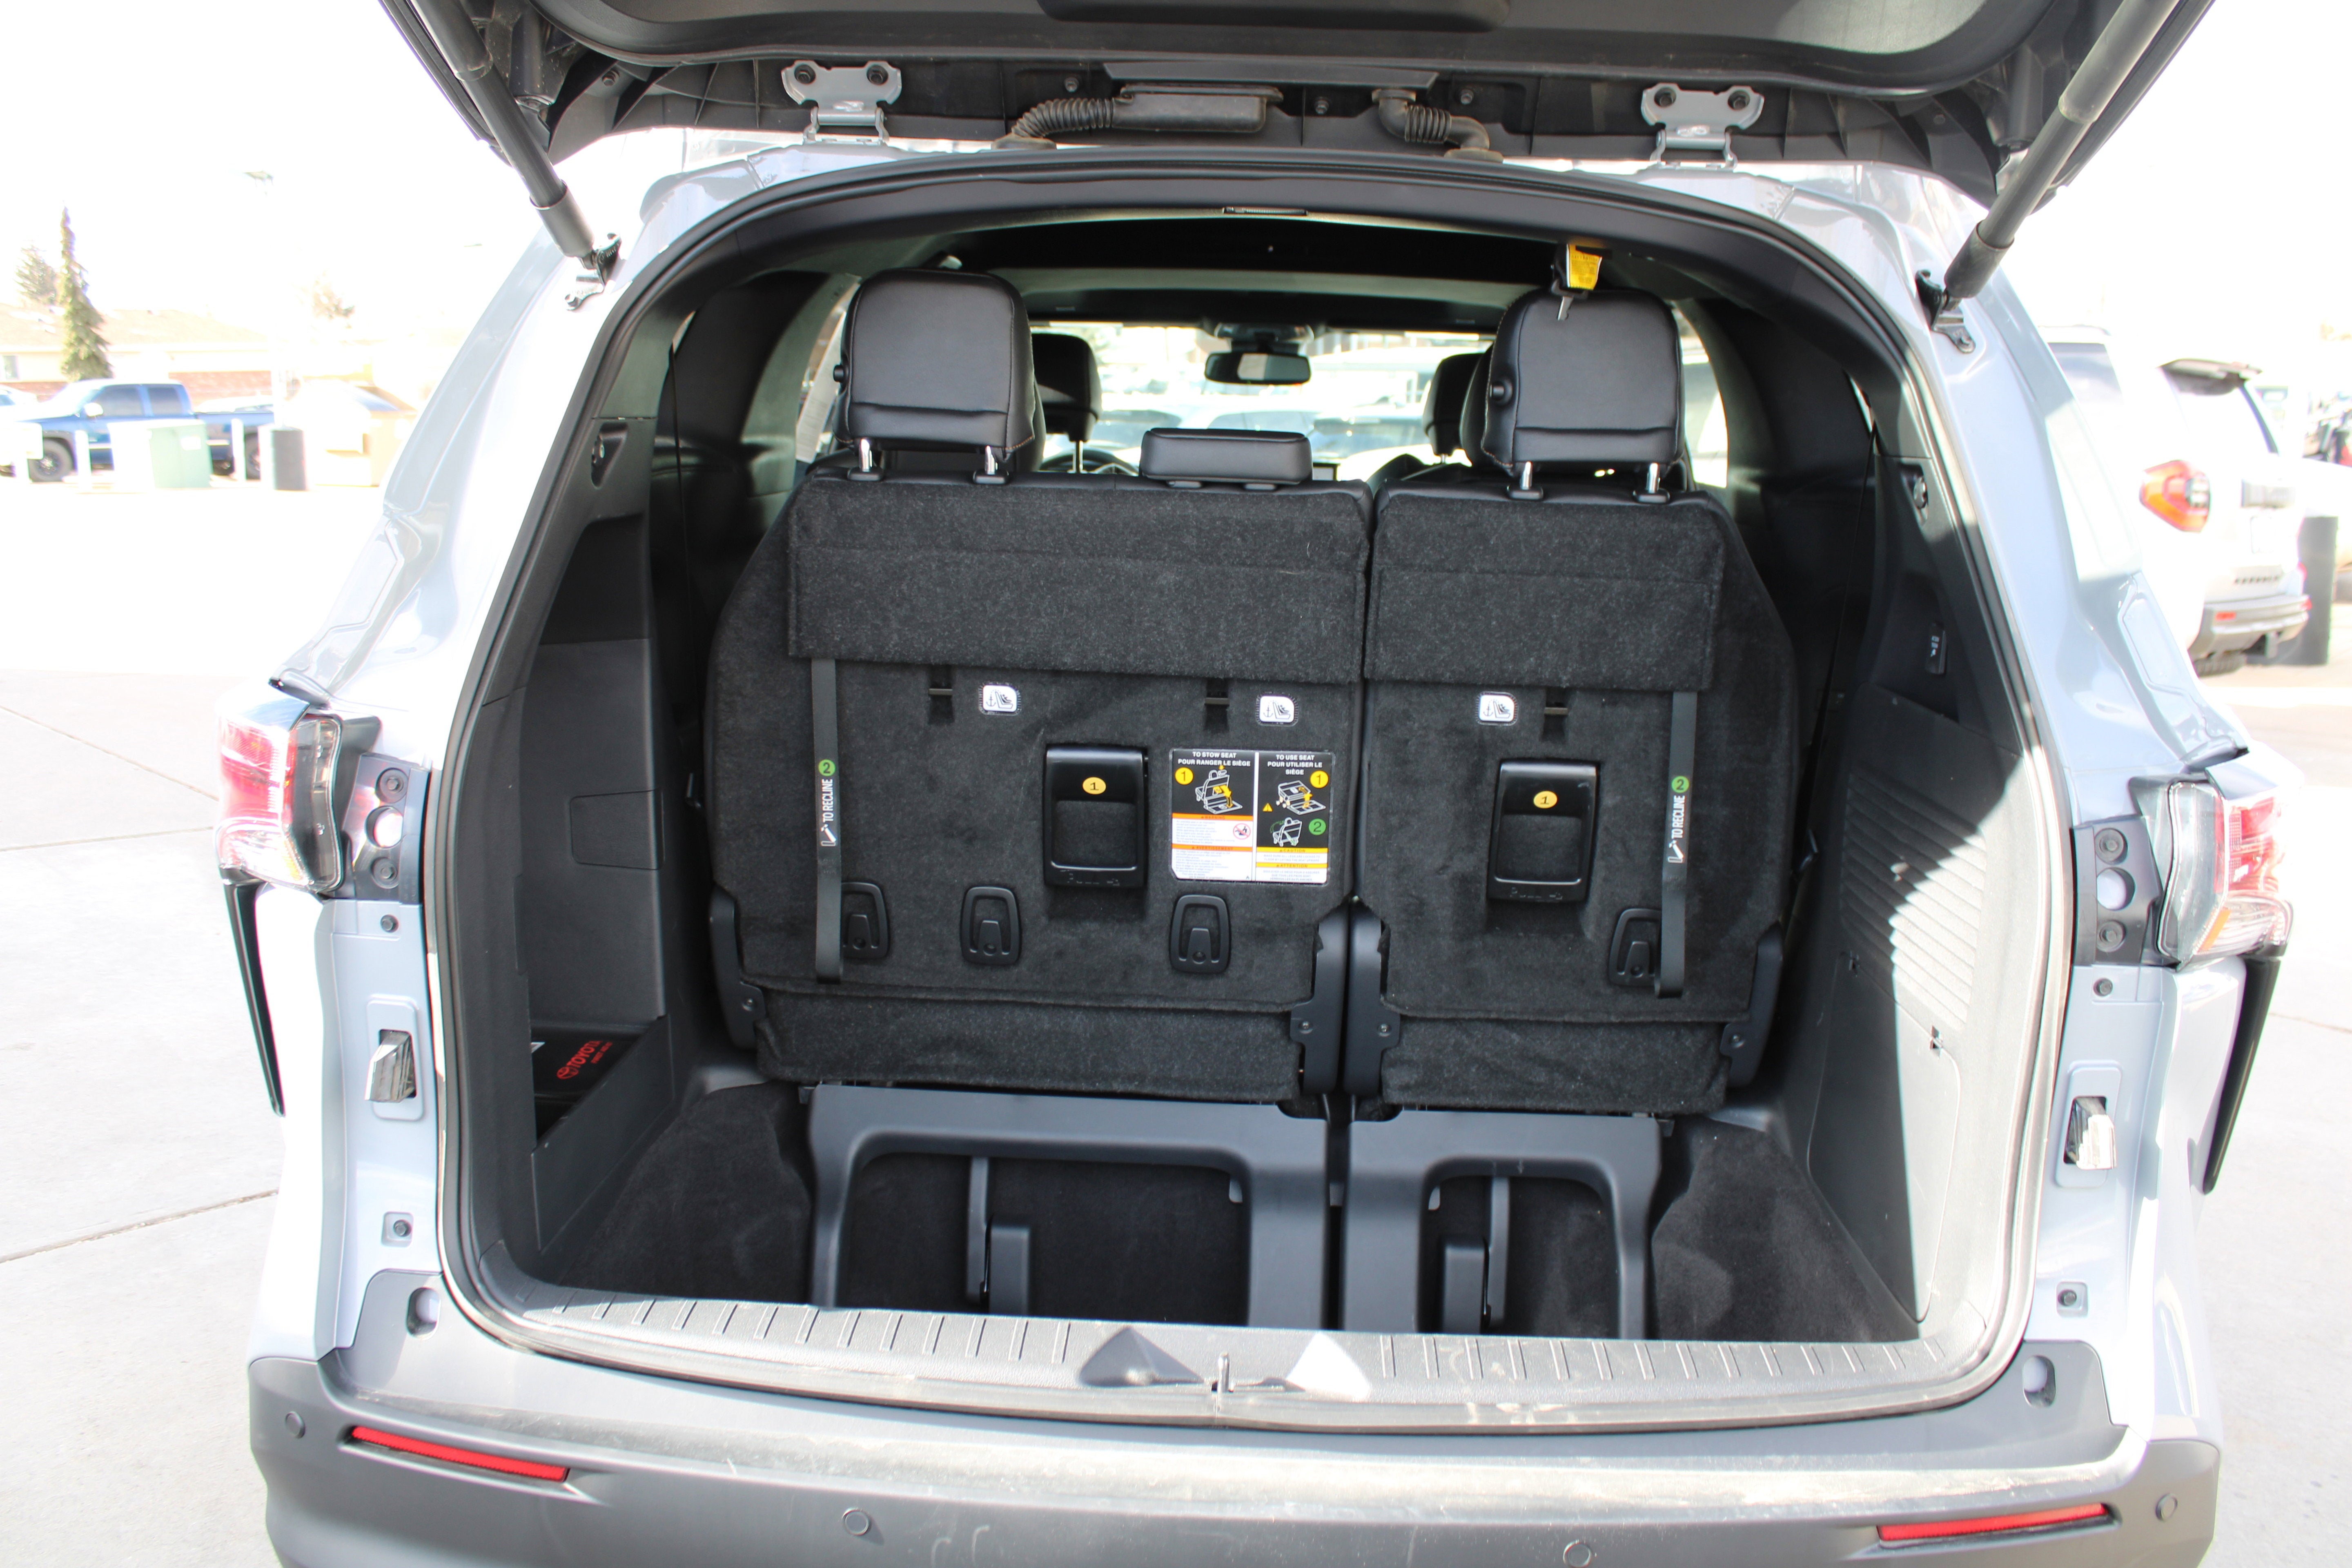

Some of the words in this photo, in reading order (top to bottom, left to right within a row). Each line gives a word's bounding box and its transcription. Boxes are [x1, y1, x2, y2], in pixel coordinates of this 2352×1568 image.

[822, 762, 831, 774] 2
[1181, 771, 1186, 782] 1
[1316, 774, 1321, 785] 1
[1090, 782, 1100, 791] 1
[1676, 779, 1684, 790] 2
[821, 778, 834, 811] RECLINE
[1540, 795, 1550, 805] 1
[1672, 795, 1685, 828] RECLINE
[822, 812, 834, 823] TO
[1313, 821, 1322, 832] 2
[1671, 829, 1684, 839] TO
[565, 1041, 604, 1068] TOYOTA
